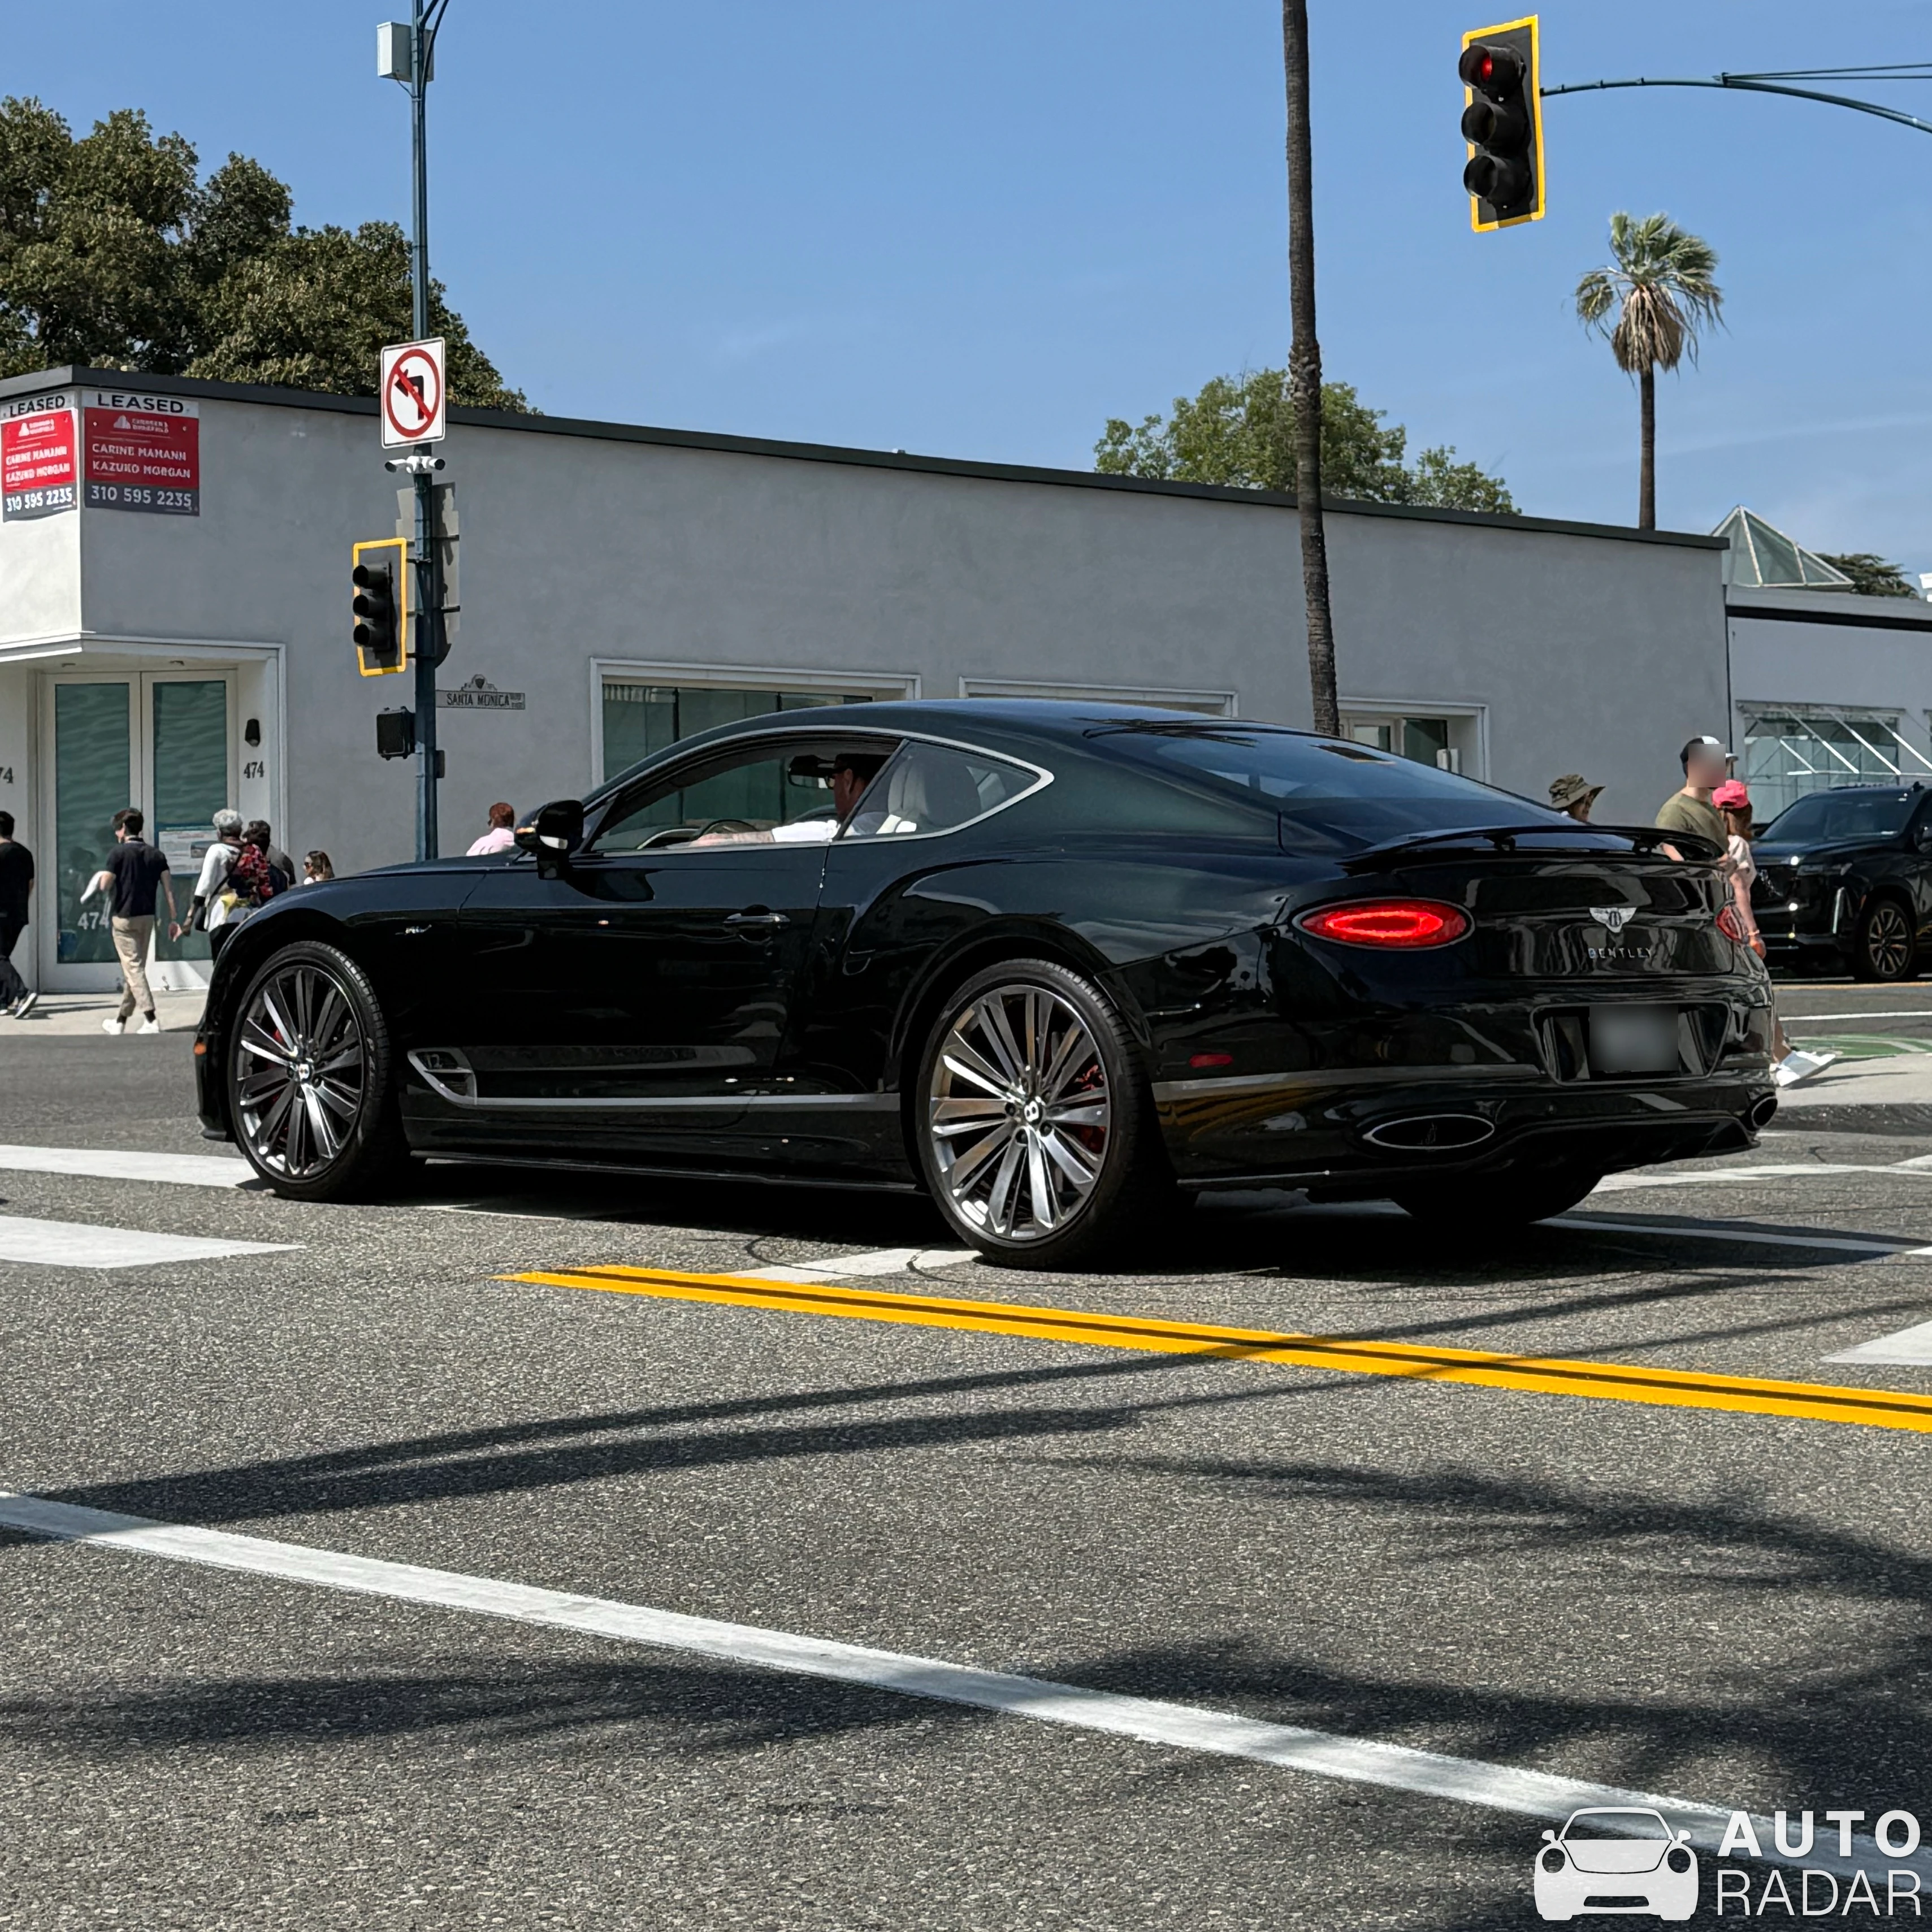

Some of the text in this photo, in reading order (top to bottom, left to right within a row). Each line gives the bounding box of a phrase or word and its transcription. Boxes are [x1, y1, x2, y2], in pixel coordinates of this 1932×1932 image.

[10, 395, 65, 417] LEASED
[98, 393, 183, 413] LEASED
[92, 444, 134, 456] CARINE
[93, 461, 139, 474] KAZUKO
[143, 465, 190, 478] MORGAN
[6, 487, 72, 512] 310 595 2235
[91, 485, 192, 507] 310 595 2235
[447, 693, 473, 705] SANTA
[477, 694, 510, 707] MONICA
[244, 761, 264, 778] 474
[77, 912, 110, 930] 474
[1588, 947, 1651, 959] BENTLEY
